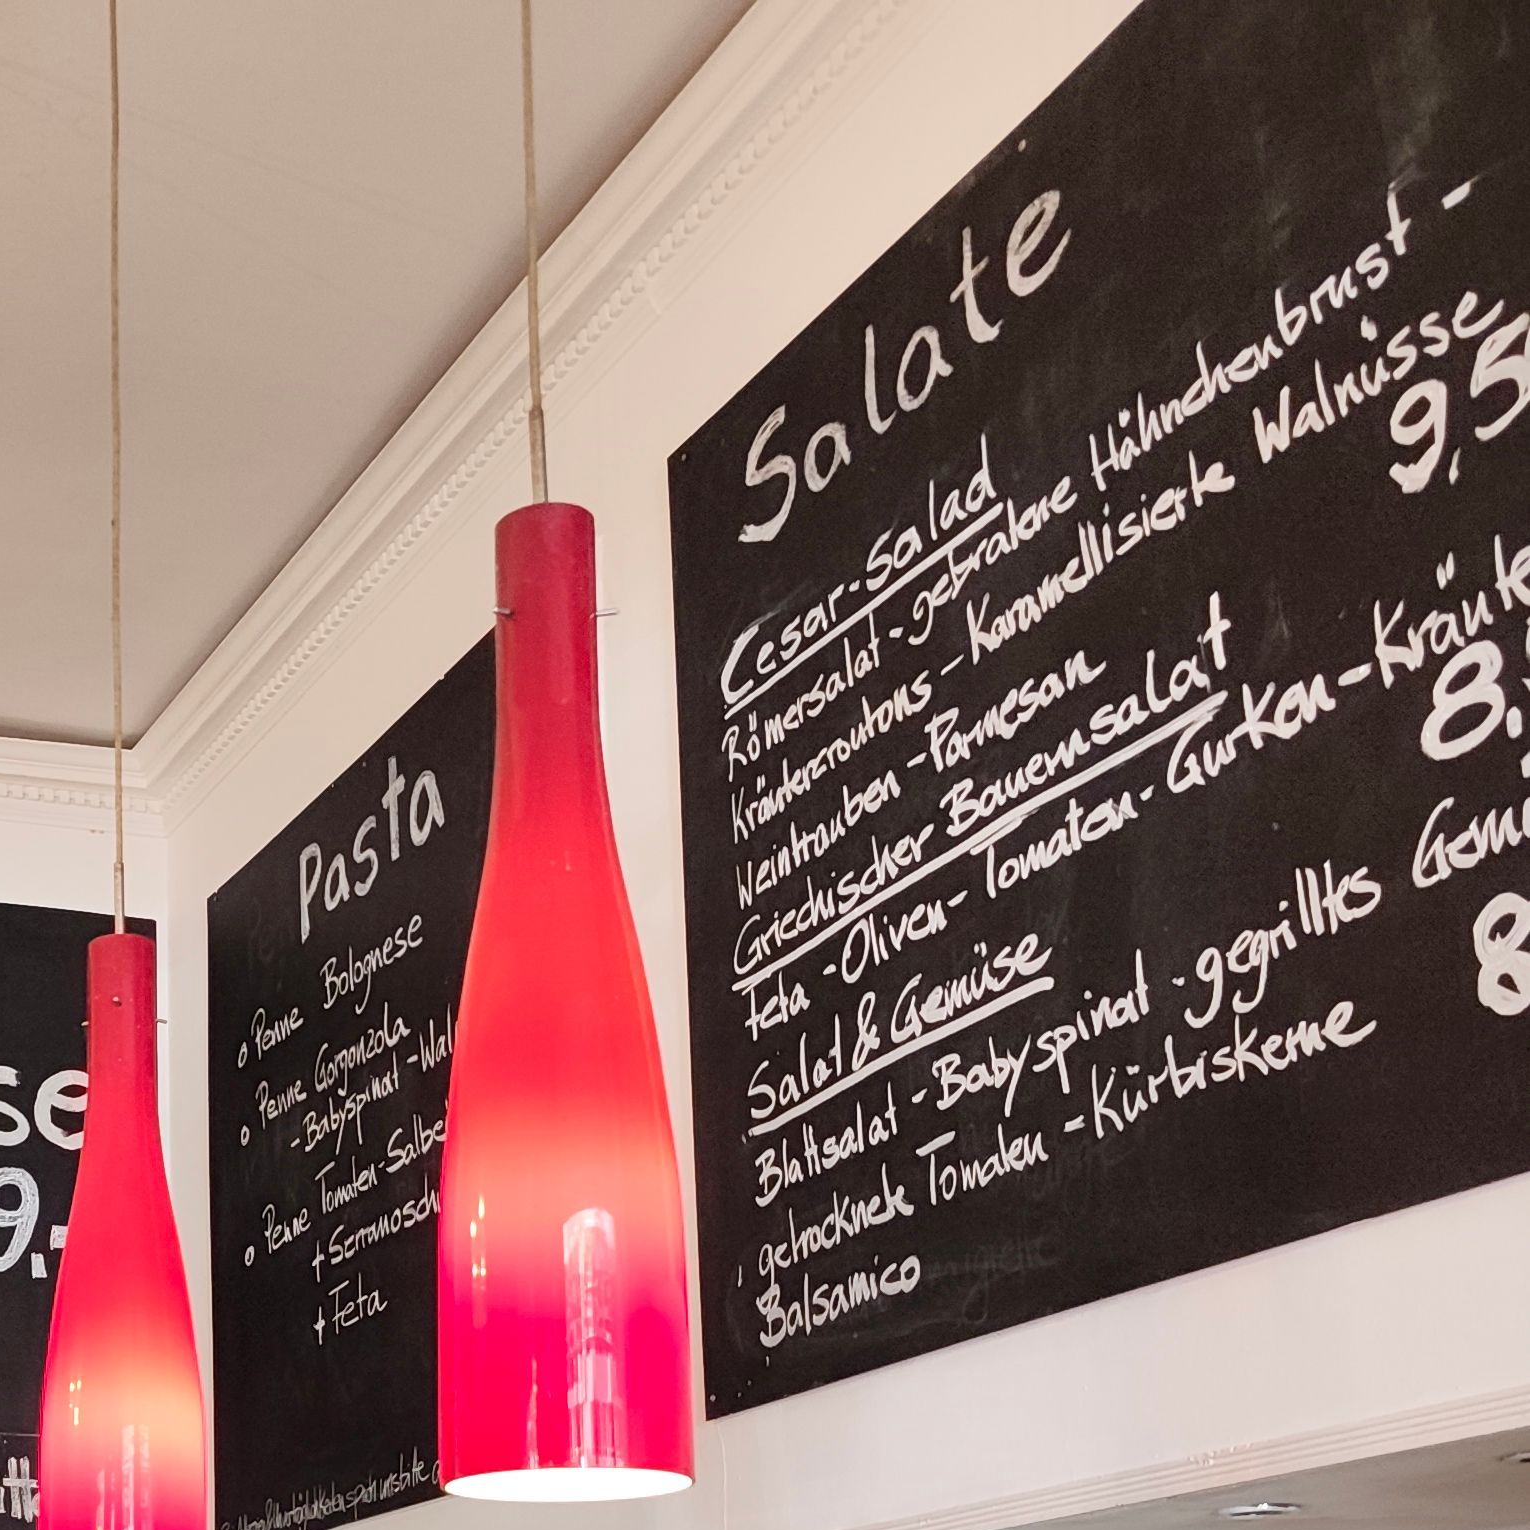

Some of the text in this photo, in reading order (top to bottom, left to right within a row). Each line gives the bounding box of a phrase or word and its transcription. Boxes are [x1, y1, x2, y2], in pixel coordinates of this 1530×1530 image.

[738, 190, 1071, 543] Salate
[966, 450, 1236, 665] Karamellisierte
[1252, 291, 1504, 464] Walnüsse
[298, 755, 446, 945] Pasta
[733, 591, 1232, 976] Griechischer Bauernsalat
[736, 770, 901, 910] Weintrauben
[250, 914, 424, 1060] Penne Bolognese
[742, 975, 811, 1042] Feta
[746, 932, 1054, 1121] Salat & Gemüse
[754, 1080, 899, 1208] Blattsalat
[1183, 858, 1383, 1029] gegrilltes
[1411, 796, 1530, 889] Gem
[255, 1001, 412, 1130] Penne Gorgonzola
[262, 1203, 312, 1255] Penne
[757, 1162, 915, 1284] getrocknete
[915, 1122, 1050, 1206] Tomaten
[328, 1271, 389, 1335] Feta
[756, 1254, 922, 1349] Balsamico
